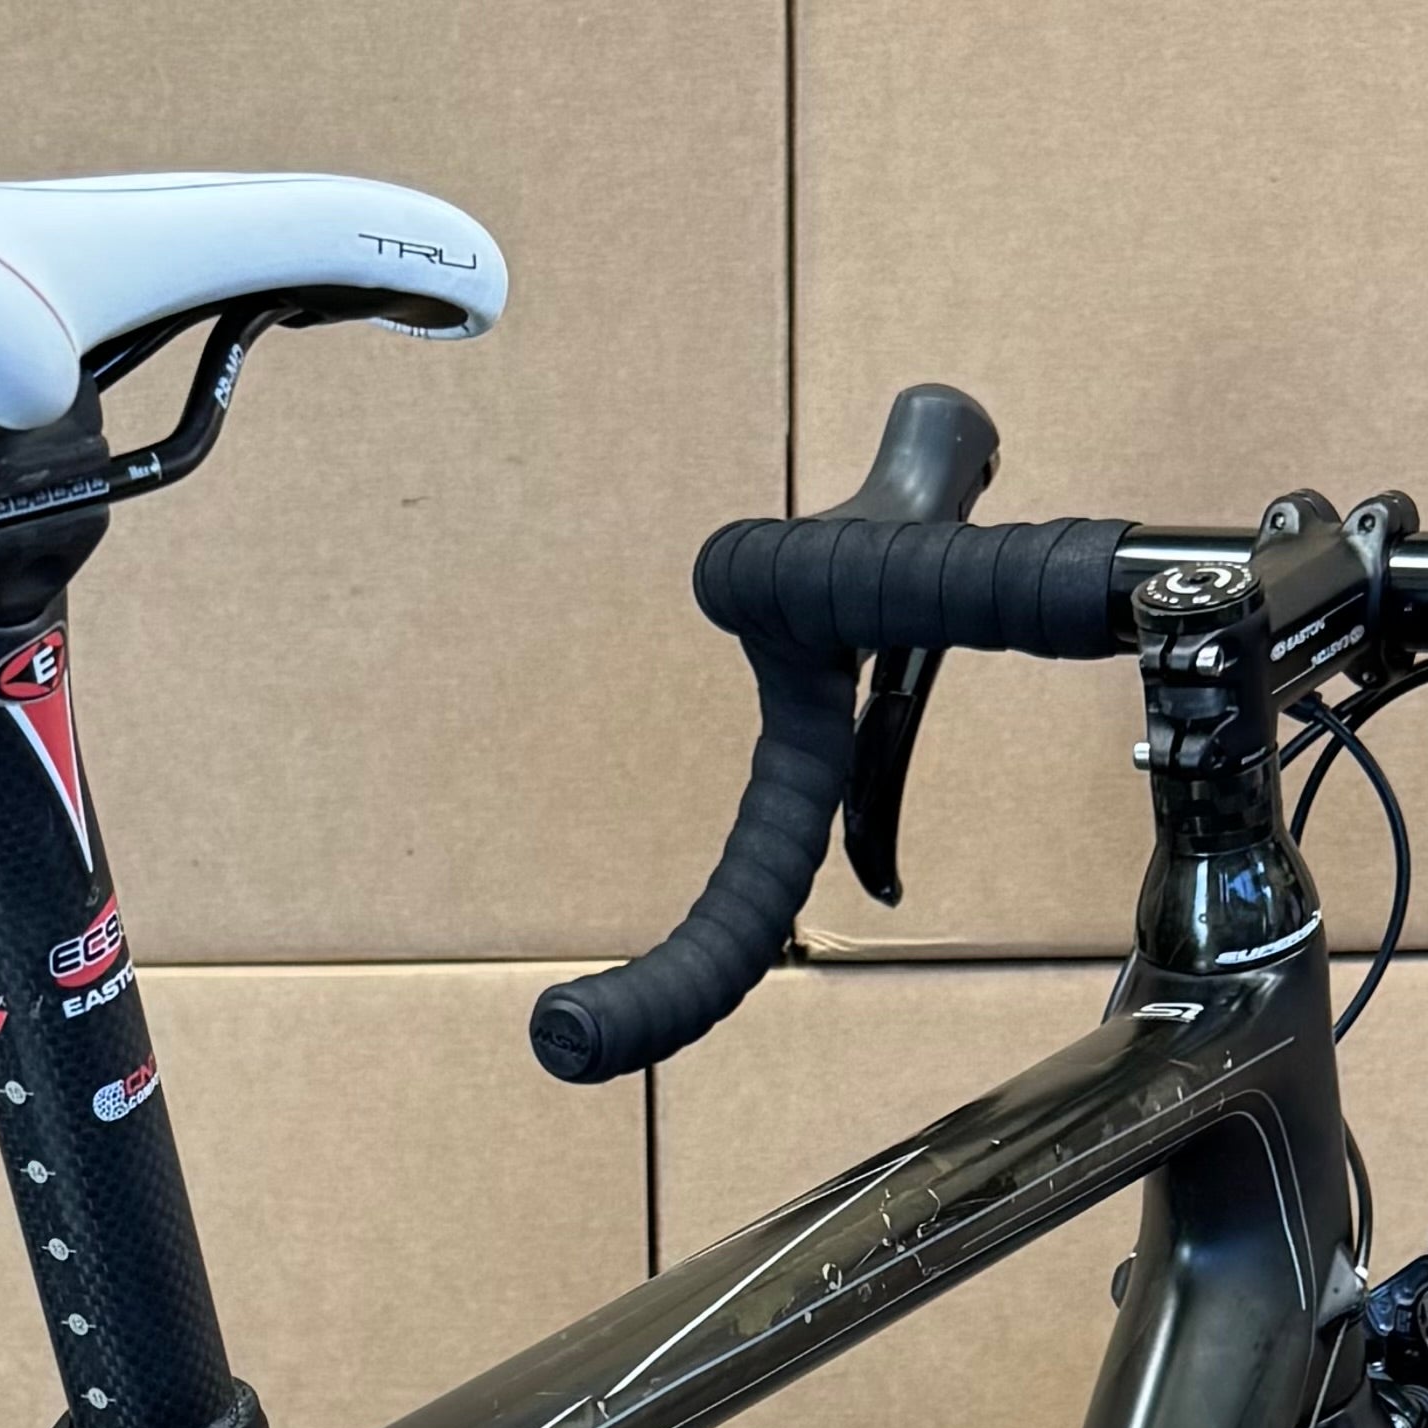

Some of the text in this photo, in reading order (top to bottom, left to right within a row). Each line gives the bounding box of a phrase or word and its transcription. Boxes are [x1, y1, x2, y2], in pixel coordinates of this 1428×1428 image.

[358, 233, 476, 270] TRU
[50, 909, 125, 978] EC9
[62, 958, 136, 1019] EASTO
